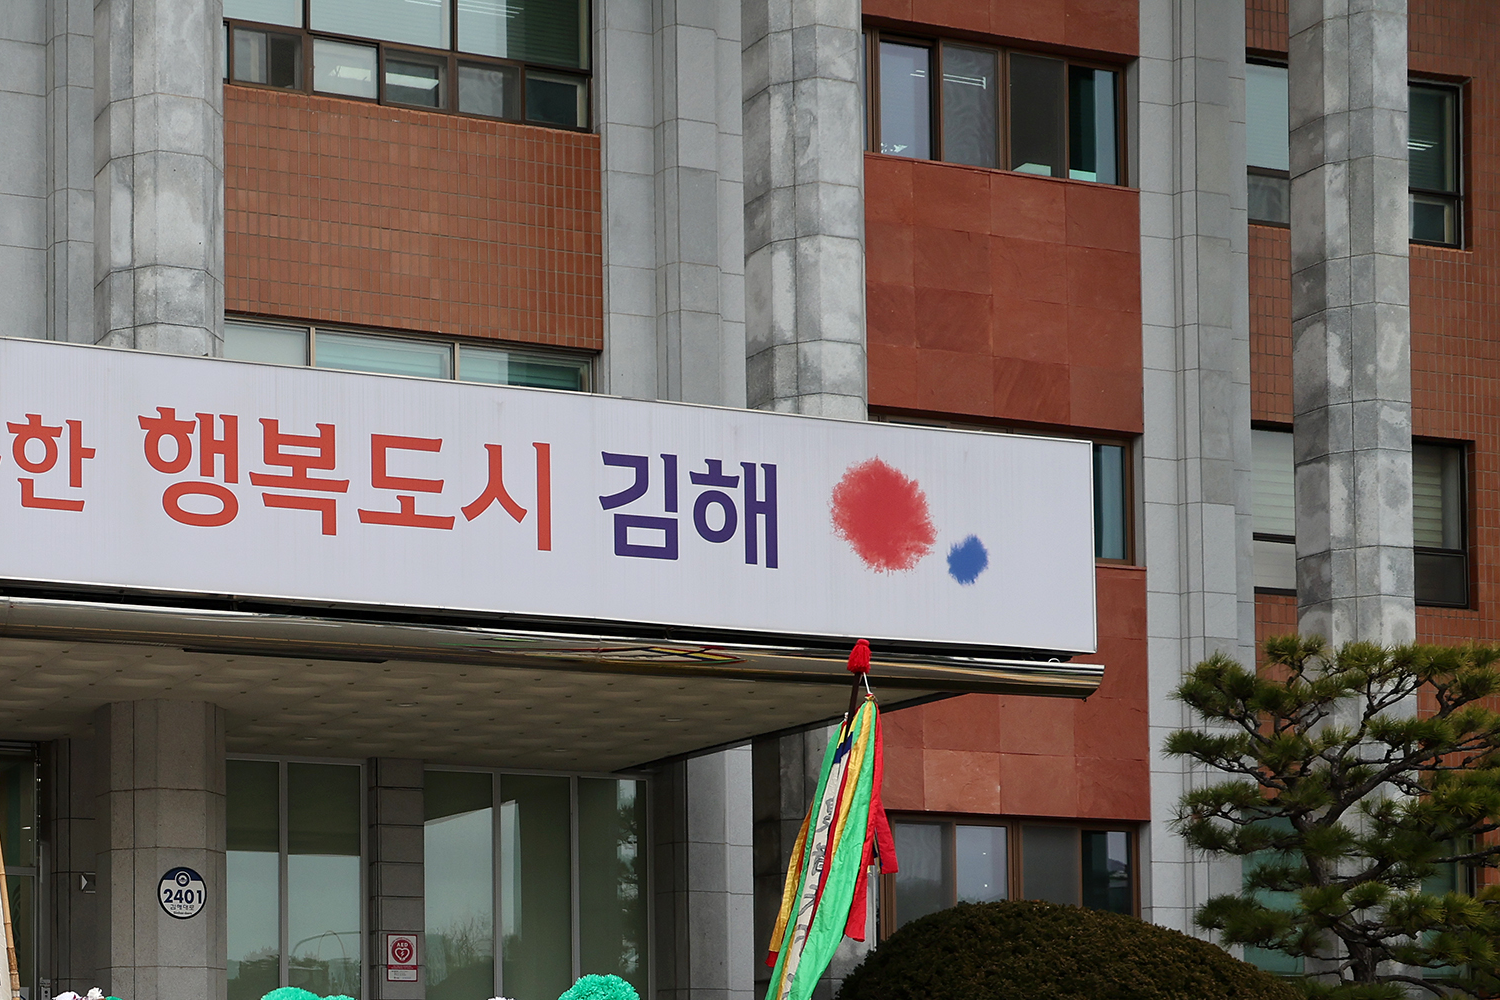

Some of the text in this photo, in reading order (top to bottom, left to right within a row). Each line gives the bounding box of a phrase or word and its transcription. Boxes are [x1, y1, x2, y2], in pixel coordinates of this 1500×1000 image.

[138, 406, 552, 552] 행복도시
[599, 451, 779, 569] 김해
[163, 889, 202, 904] 2401
